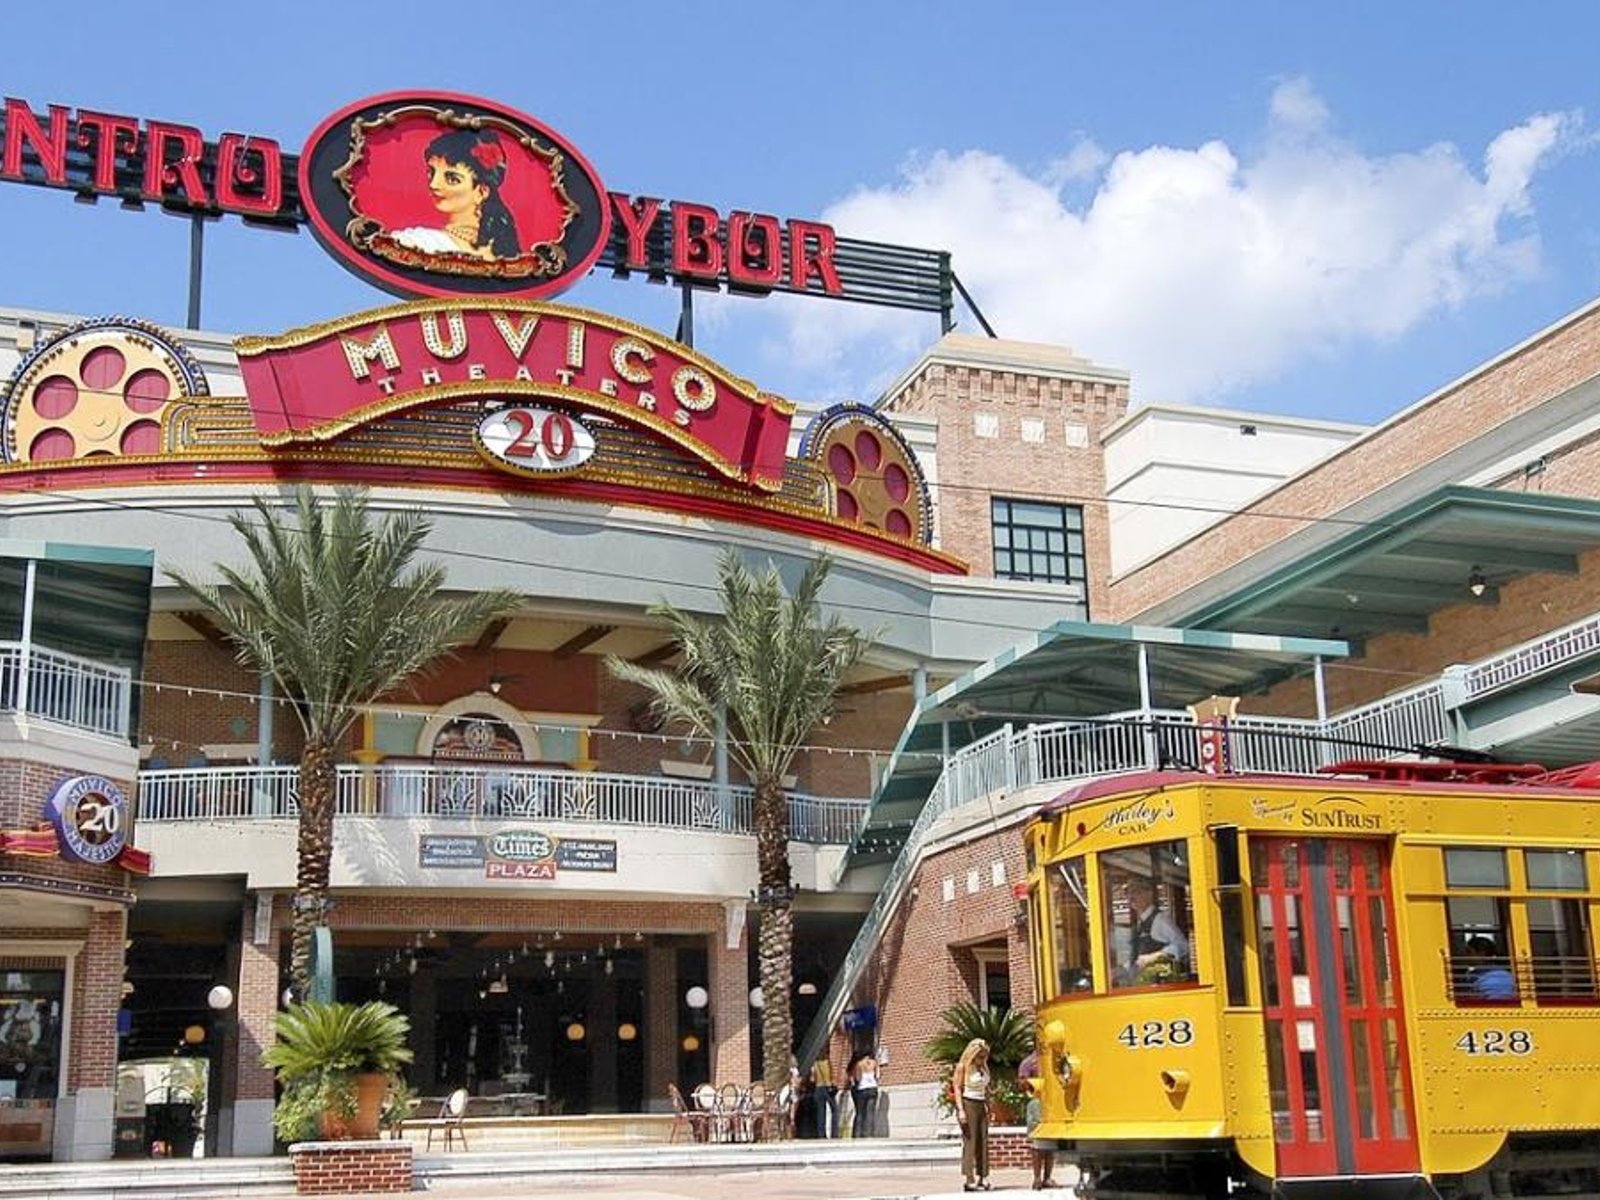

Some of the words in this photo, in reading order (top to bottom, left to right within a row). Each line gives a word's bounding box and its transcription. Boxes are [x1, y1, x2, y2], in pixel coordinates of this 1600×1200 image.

[1, 97, 282, 215] NTRO
[608, 192, 844, 296] YBOR
[338, 310, 717, 413] MUVICO
[378, 364, 693, 427] THEATERS
[503, 409, 575, 460] 20
[71, 777, 121, 805] MUVICO
[79, 803, 119, 834] 20
[1118, 824, 1148, 836] CAR
[493, 835, 550, 857] Times
[489, 863, 552, 878] PLAZA
[1118, 1020, 1194, 1048] 428
[1456, 1030, 1532, 1056] 428
